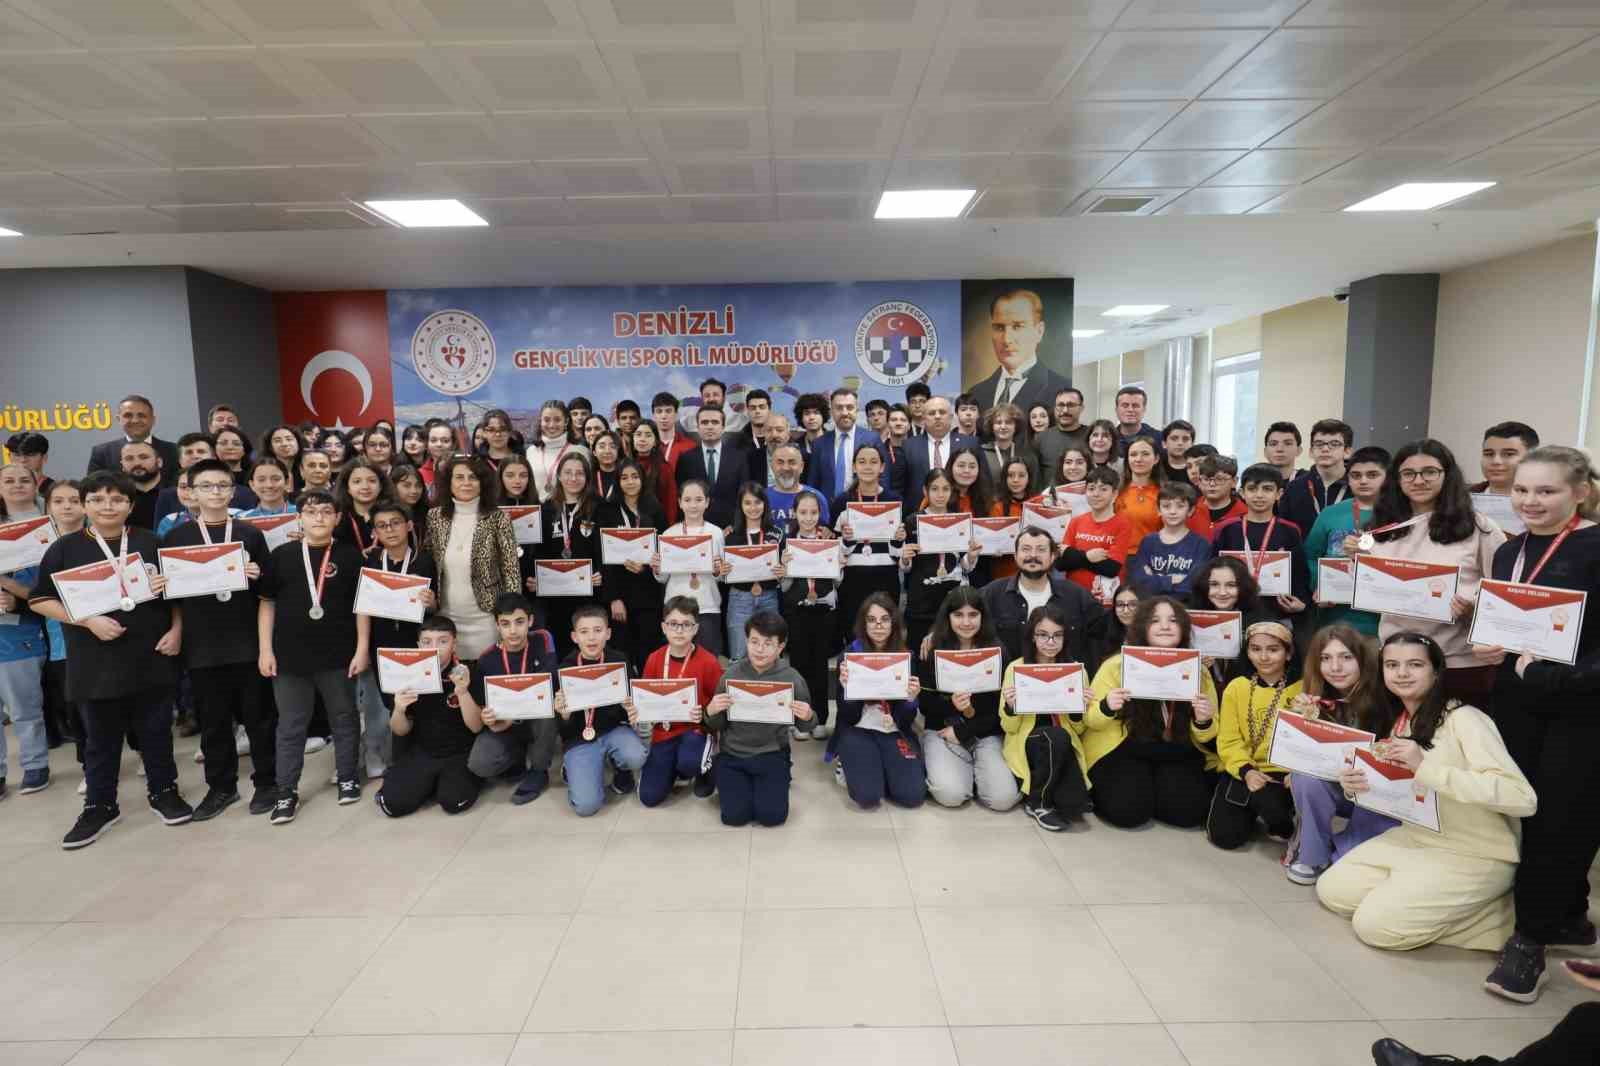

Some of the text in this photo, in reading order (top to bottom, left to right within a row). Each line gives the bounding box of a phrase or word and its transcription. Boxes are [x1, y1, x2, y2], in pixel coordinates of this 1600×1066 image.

[614, 305, 736, 338] DENİZLİ
[512, 338, 838, 375] GENÇLİK VE SPOR İL MÜDÜRLÜĞÜ
